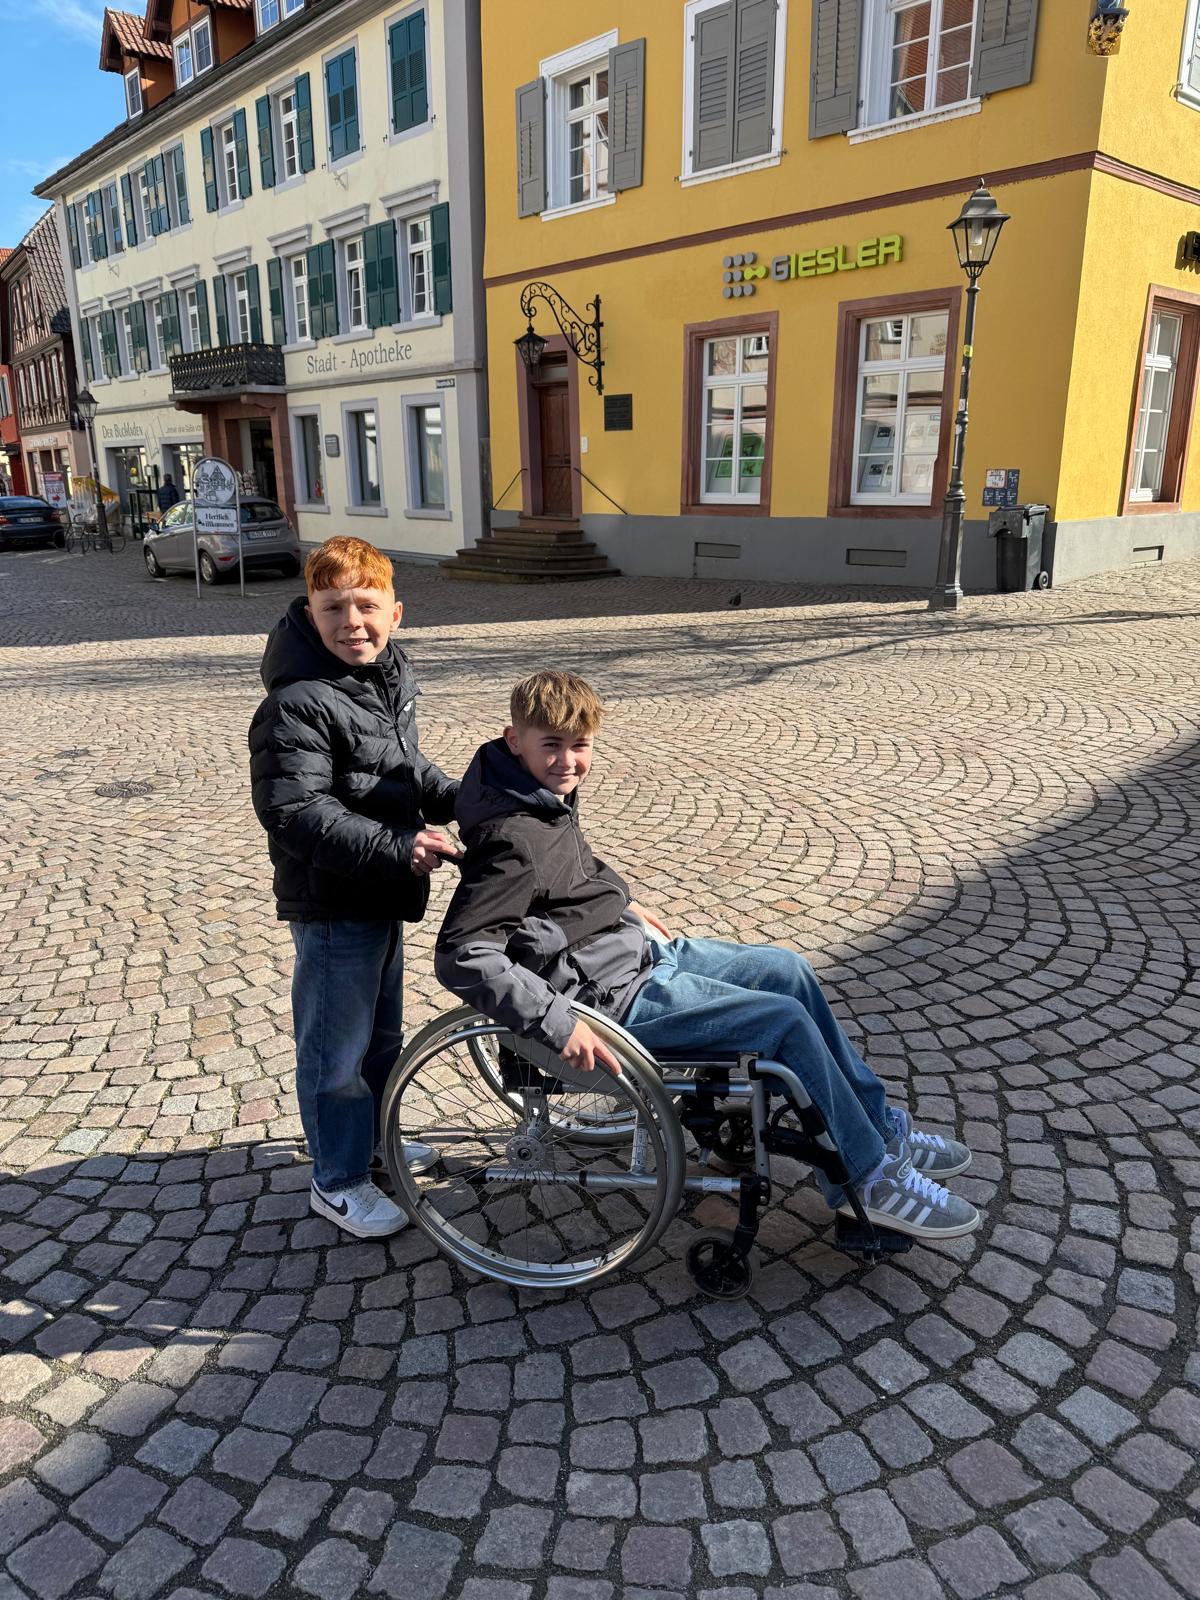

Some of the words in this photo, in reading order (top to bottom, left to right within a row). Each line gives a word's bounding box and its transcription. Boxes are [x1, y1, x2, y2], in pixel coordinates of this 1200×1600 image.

[771, 234, 903, 281] GIESLER
[306, 351, 338, 374] Stadt
[350, 340, 413, 372] Apotheke
